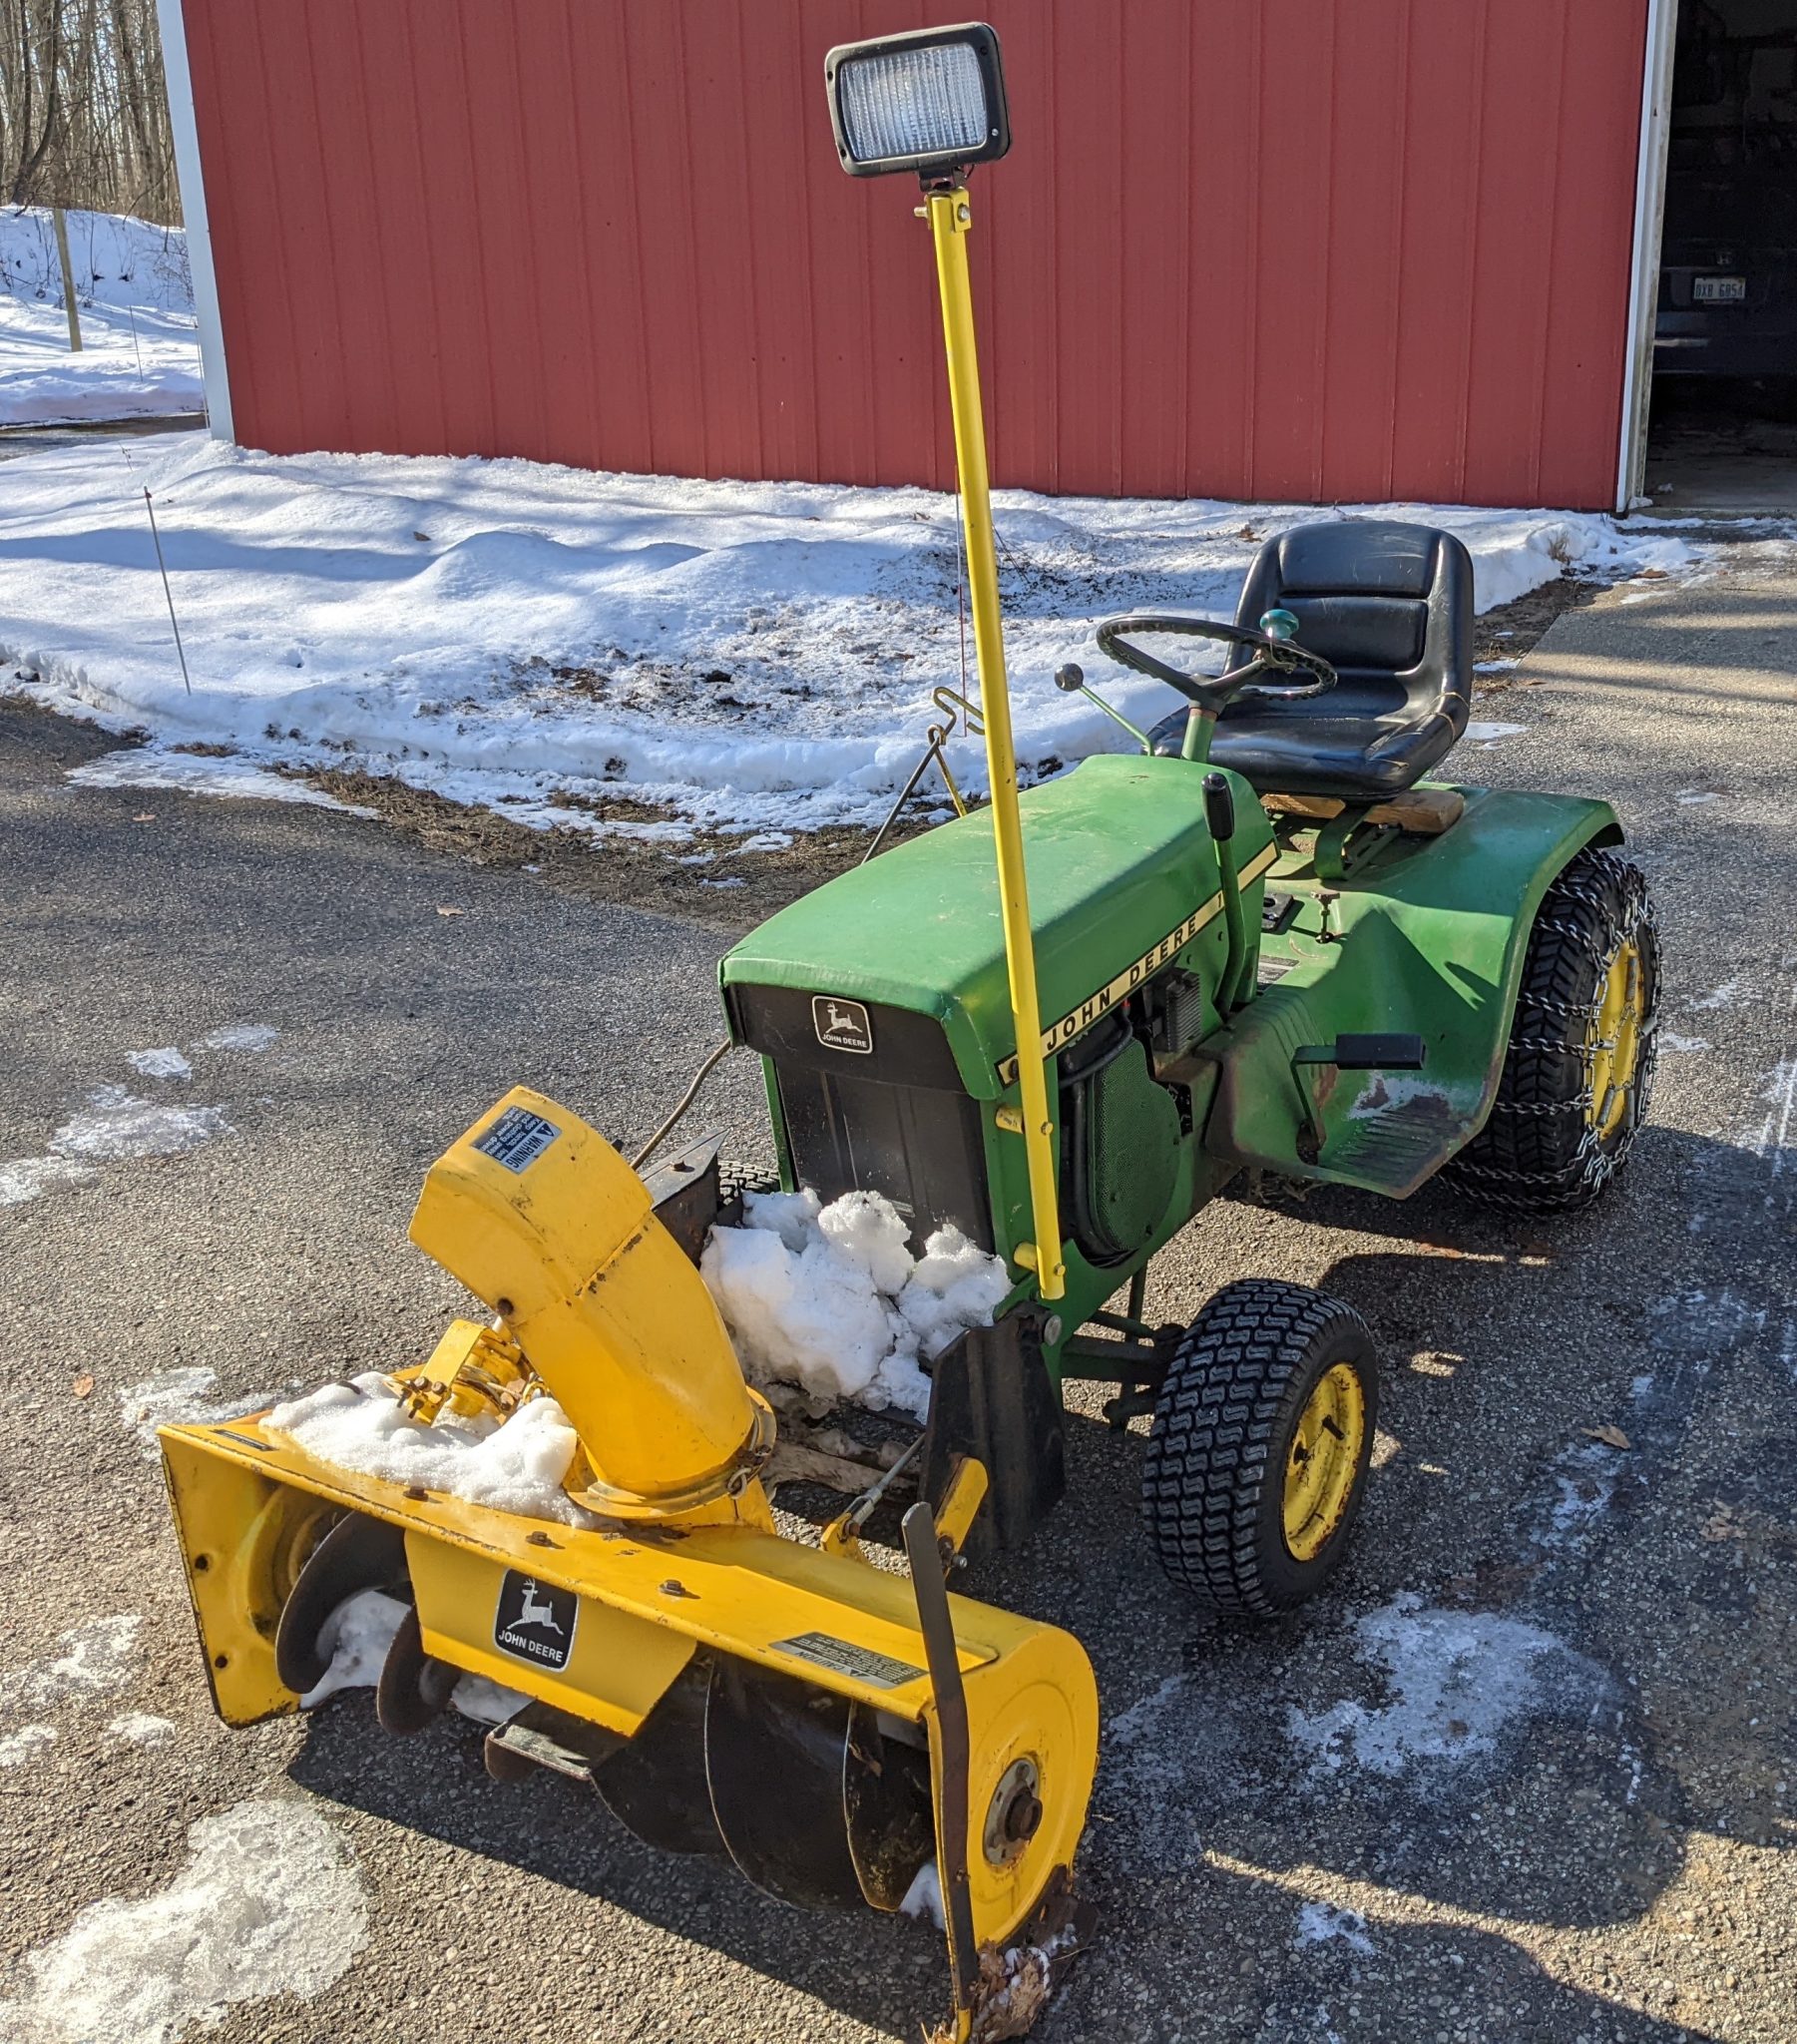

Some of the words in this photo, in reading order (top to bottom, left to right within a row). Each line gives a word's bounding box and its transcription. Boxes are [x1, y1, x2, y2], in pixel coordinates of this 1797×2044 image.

[1047, 988, 1111, 1050] JOHN
[1129, 916, 1196, 986] DEERE
[822, 1033, 842, 1044] JOHN
[842, 1037, 867, 1048] DEERE
[510, 1110, 526, 1122] from
[520, 1113, 533, 1124] and
[523, 1116, 541, 1131] Keep
[494, 1121, 513, 1136] power
[498, 1122, 523, 1143] clothing
[479, 1136, 499, 1152] driven
[504, 1134, 544, 1169] WARNING
[499, 1630, 527, 1649] JOHN
[528, 1640, 564, 1663] DEERE
[796, 1651, 845, 1671] CAUTION
